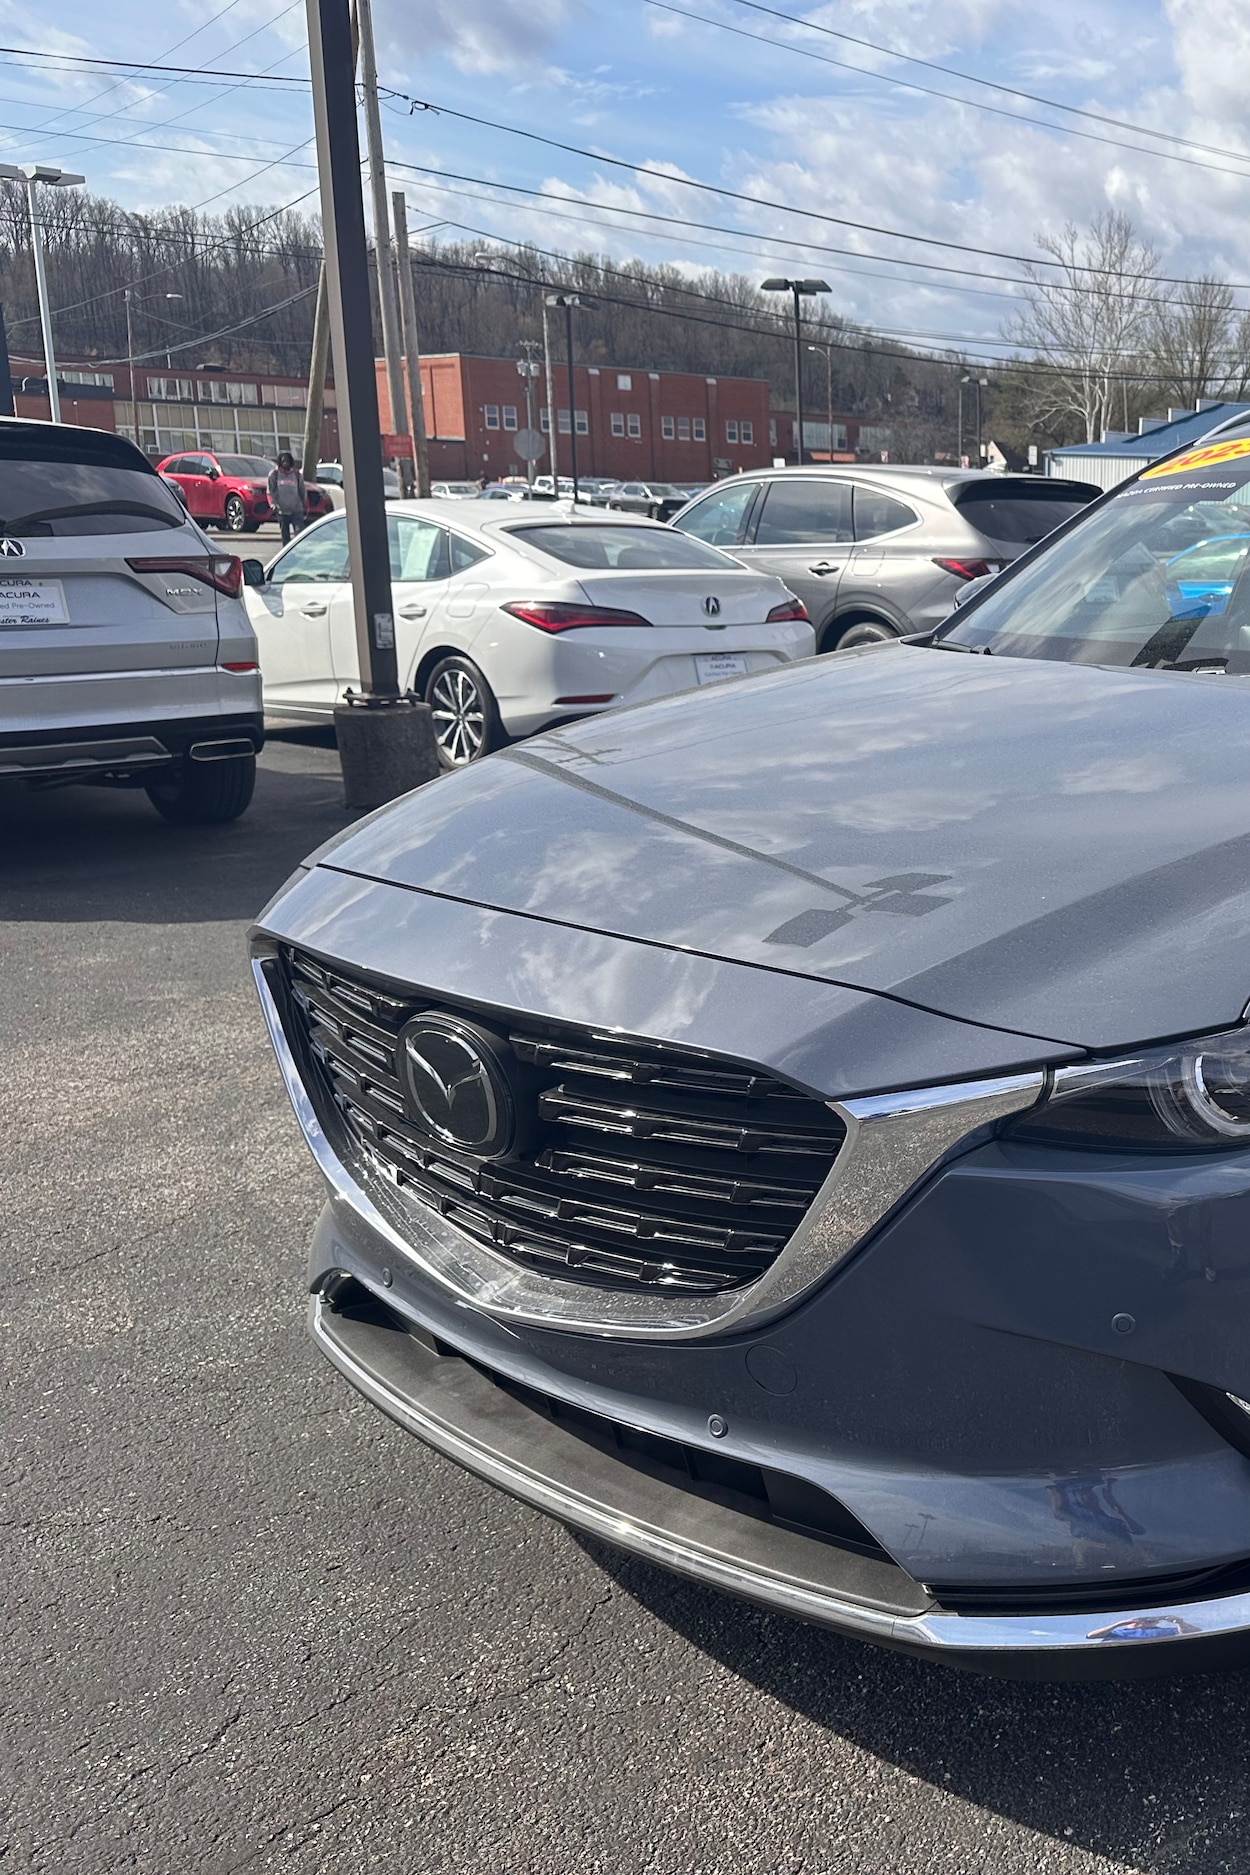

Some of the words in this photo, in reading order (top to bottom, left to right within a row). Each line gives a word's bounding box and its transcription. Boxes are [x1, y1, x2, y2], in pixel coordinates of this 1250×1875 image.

[1183, 482, 1237, 490] PRE-OWNED
[166, 588, 204, 597] MDX
[20, 615, 50, 624] Raines
